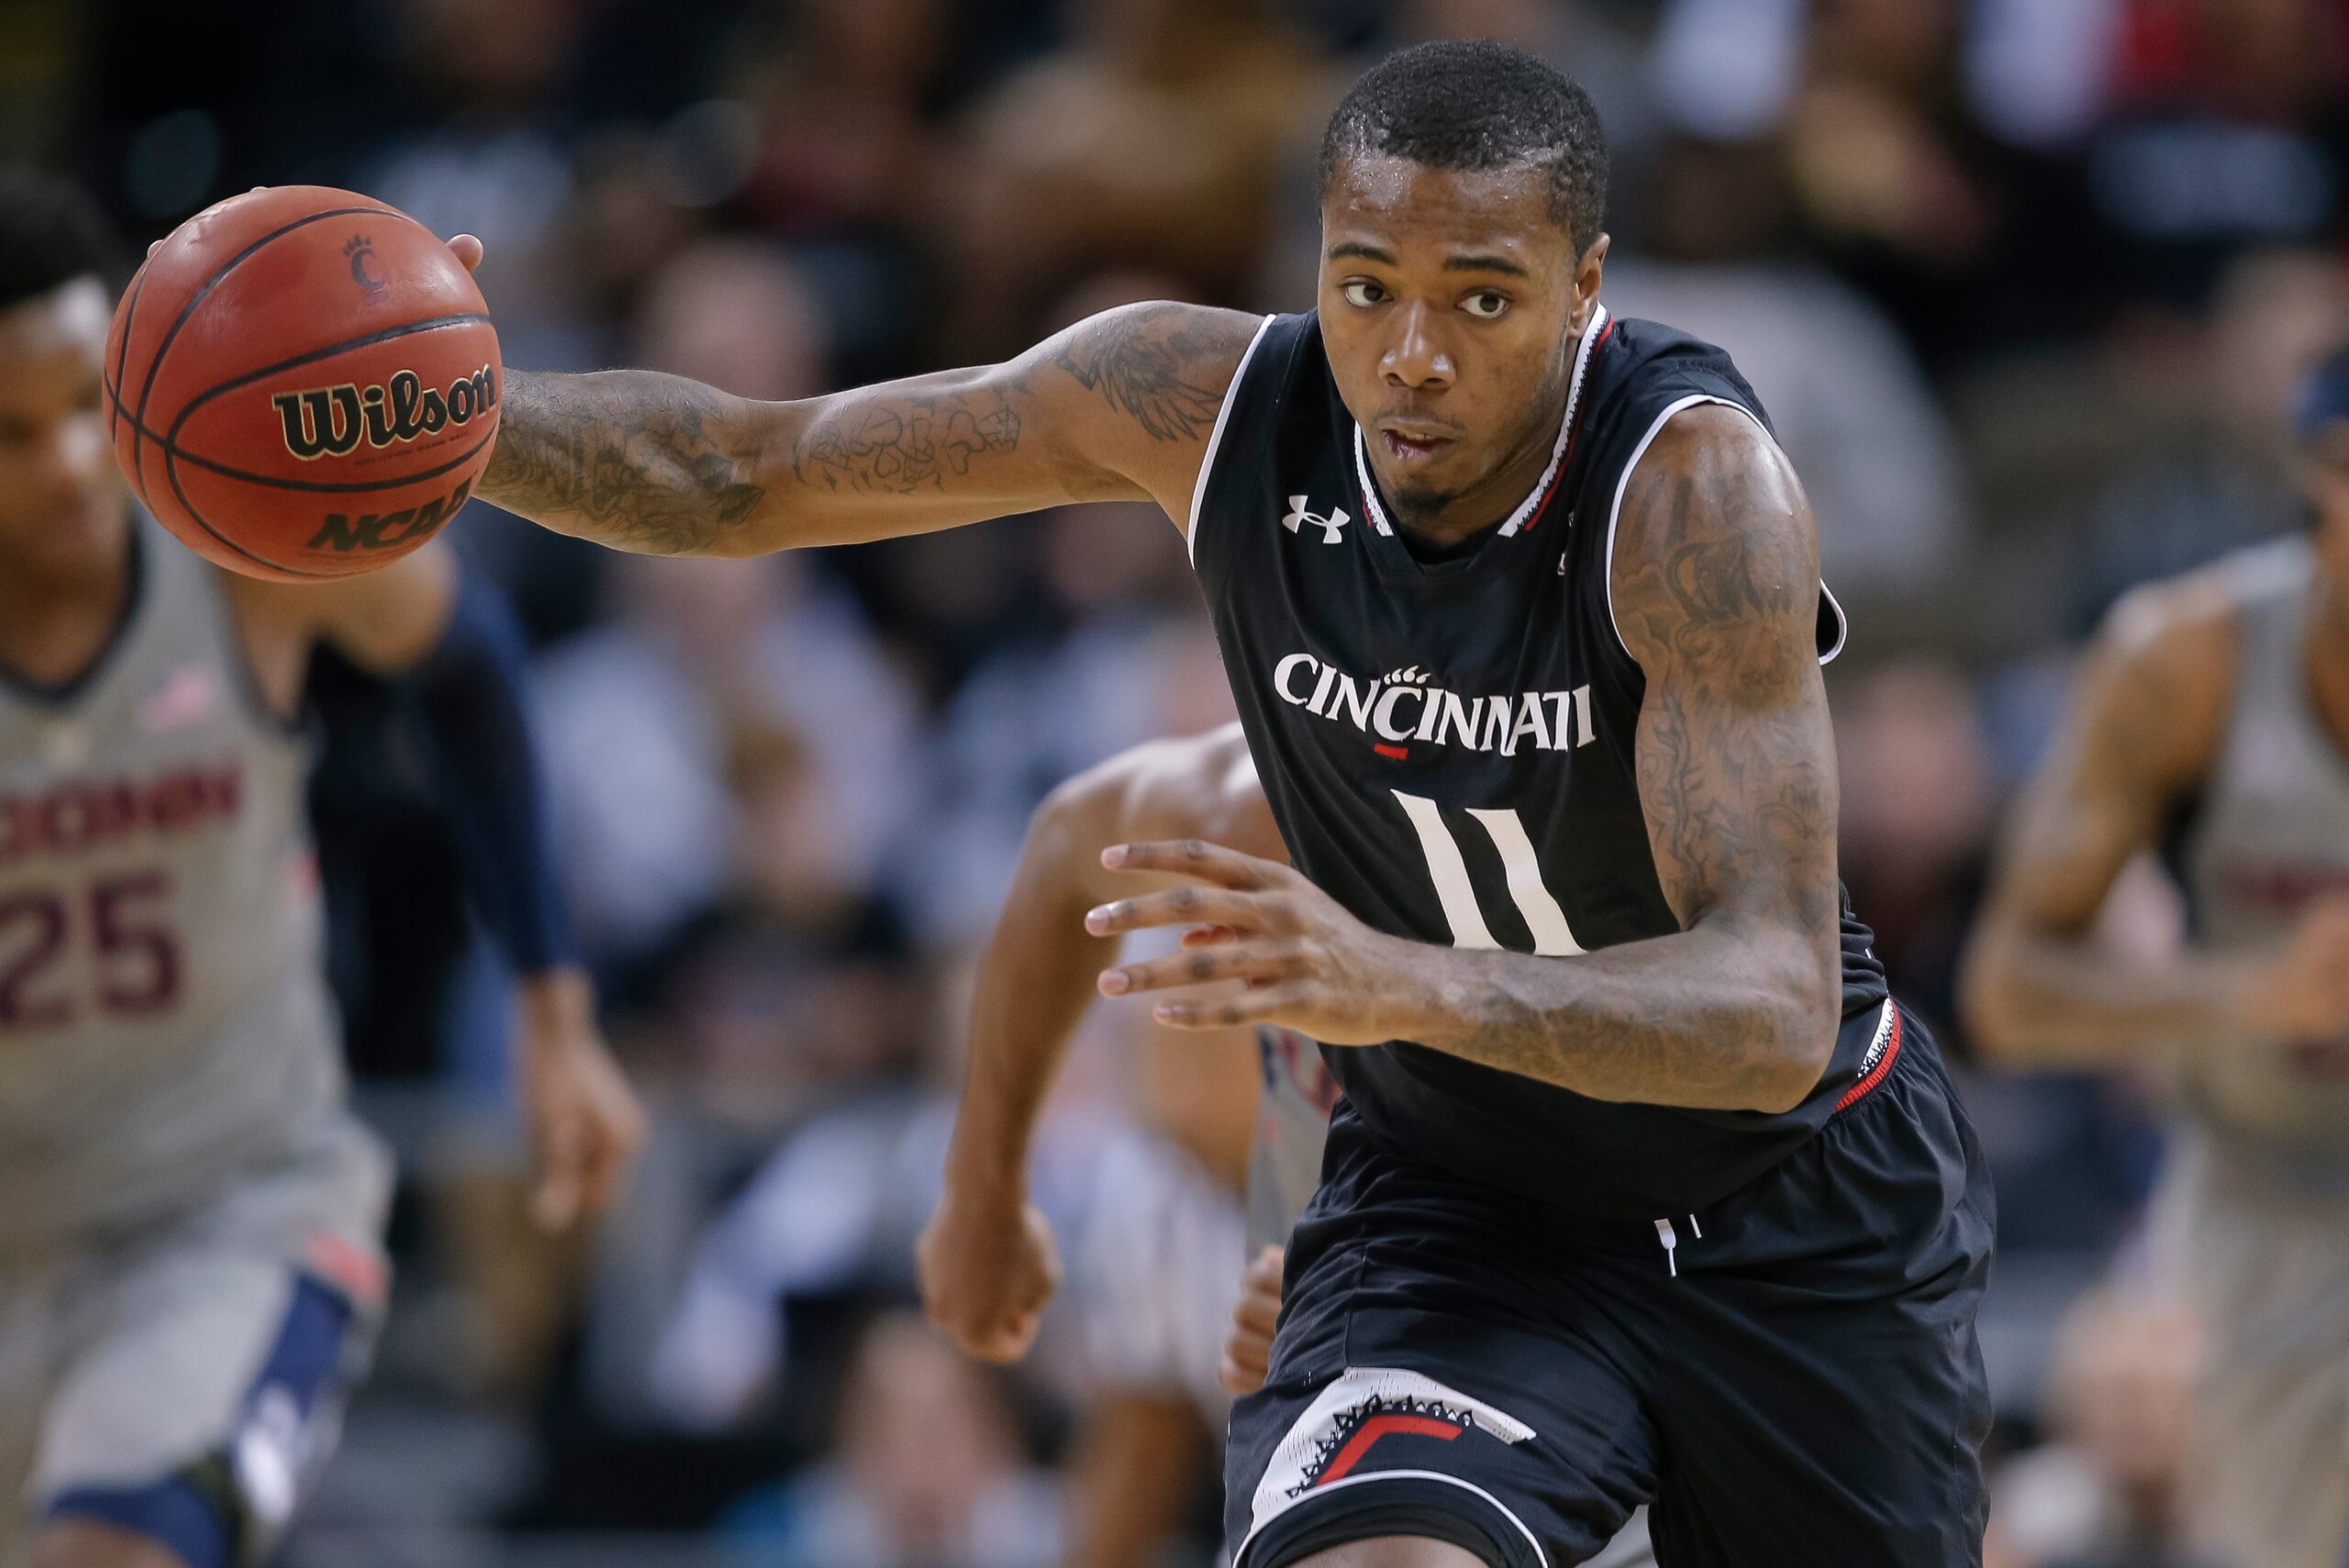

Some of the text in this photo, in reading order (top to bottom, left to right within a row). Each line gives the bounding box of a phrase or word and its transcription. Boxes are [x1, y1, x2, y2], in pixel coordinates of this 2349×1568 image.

[272, 364, 496, 461] Wilson
[305, 476, 473, 551] NCAA
[1274, 652, 1597, 757] CINCINNATI
[1389, 788, 1590, 956] 11
[0, 869, 185, 1032] 25
